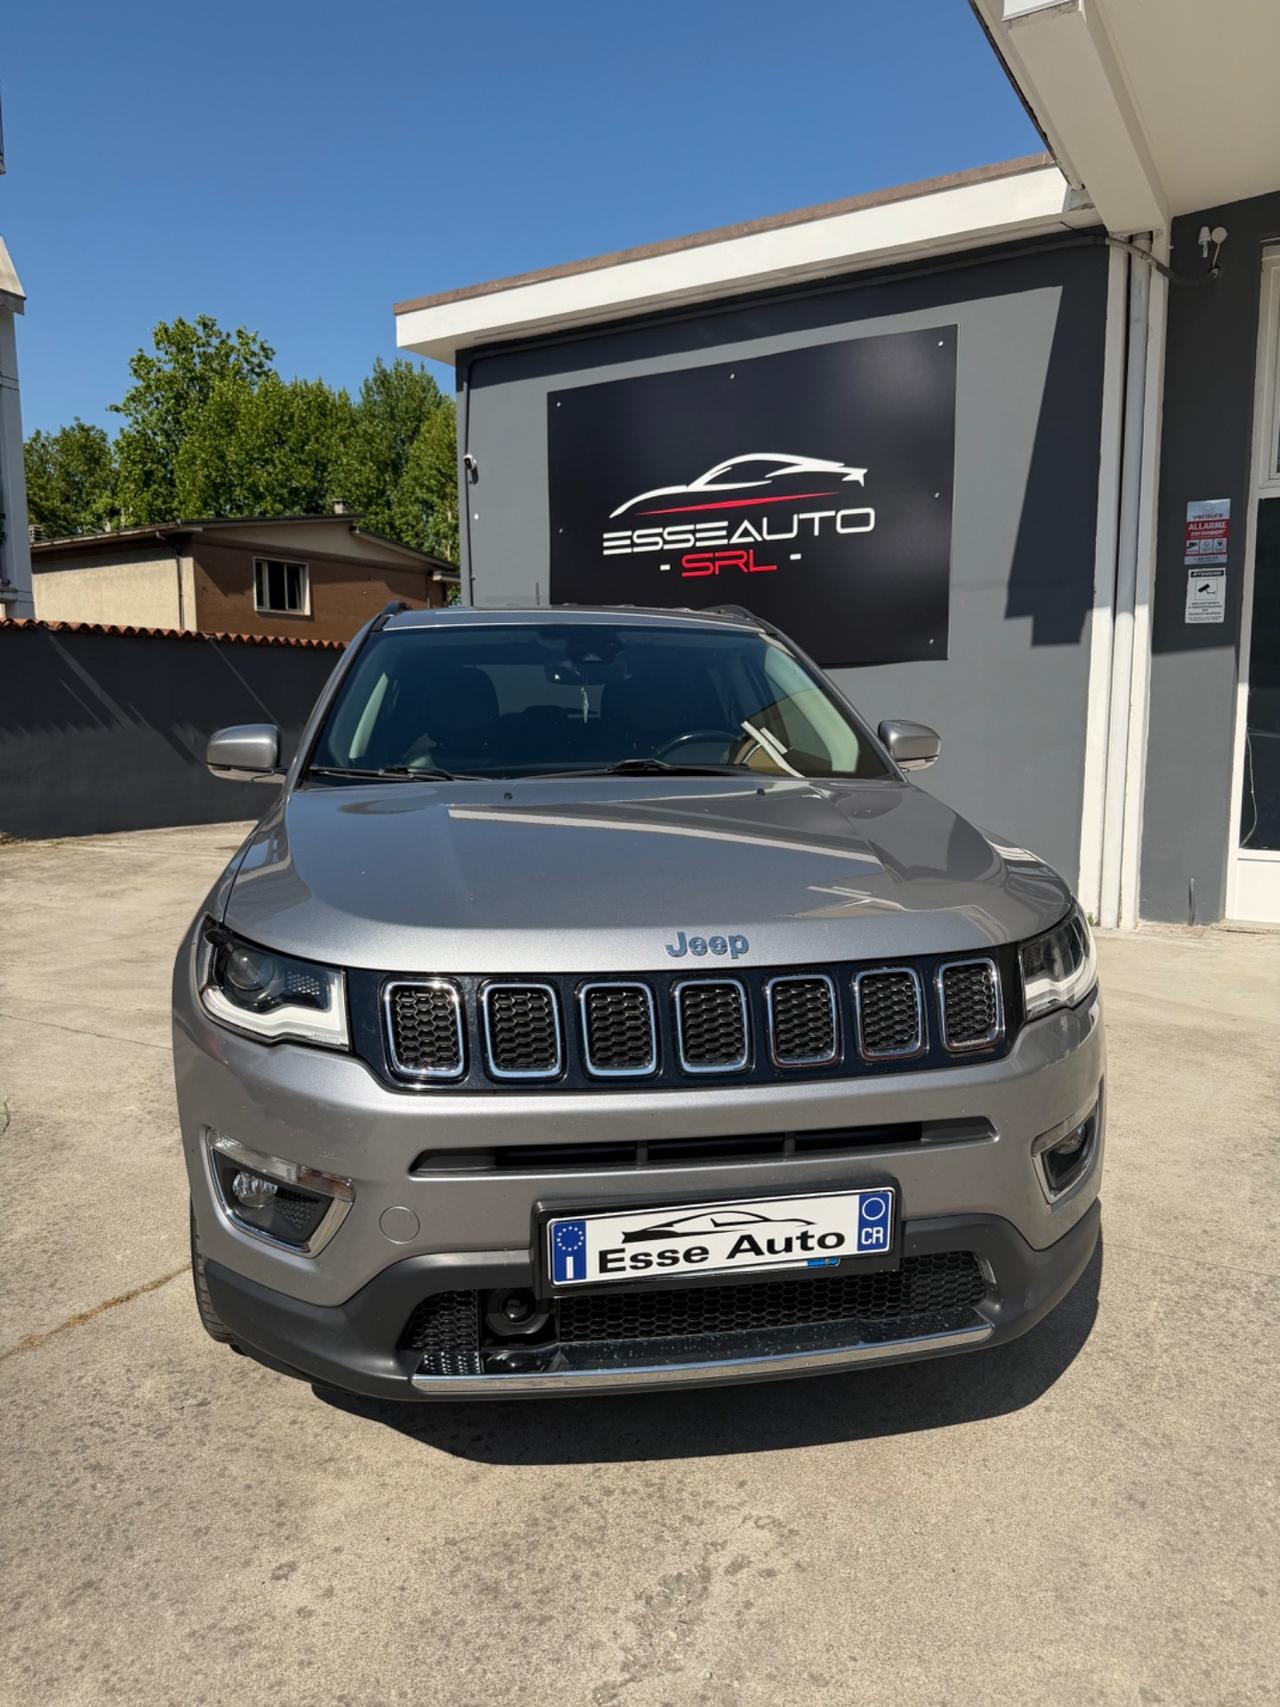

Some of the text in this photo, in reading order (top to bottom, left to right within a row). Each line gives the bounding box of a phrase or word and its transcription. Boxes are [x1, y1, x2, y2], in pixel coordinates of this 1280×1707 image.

[603, 507, 875, 555] ESSEAUTO
[1188, 521, 1227, 531] ALLARME
[681, 549, 778, 577] SRL
[665, 931, 750, 959] Jeep
[598, 1247, 710, 1274] Esse
[726, 1234, 846, 1260] Auto
[861, 1227, 885, 1245] CR
